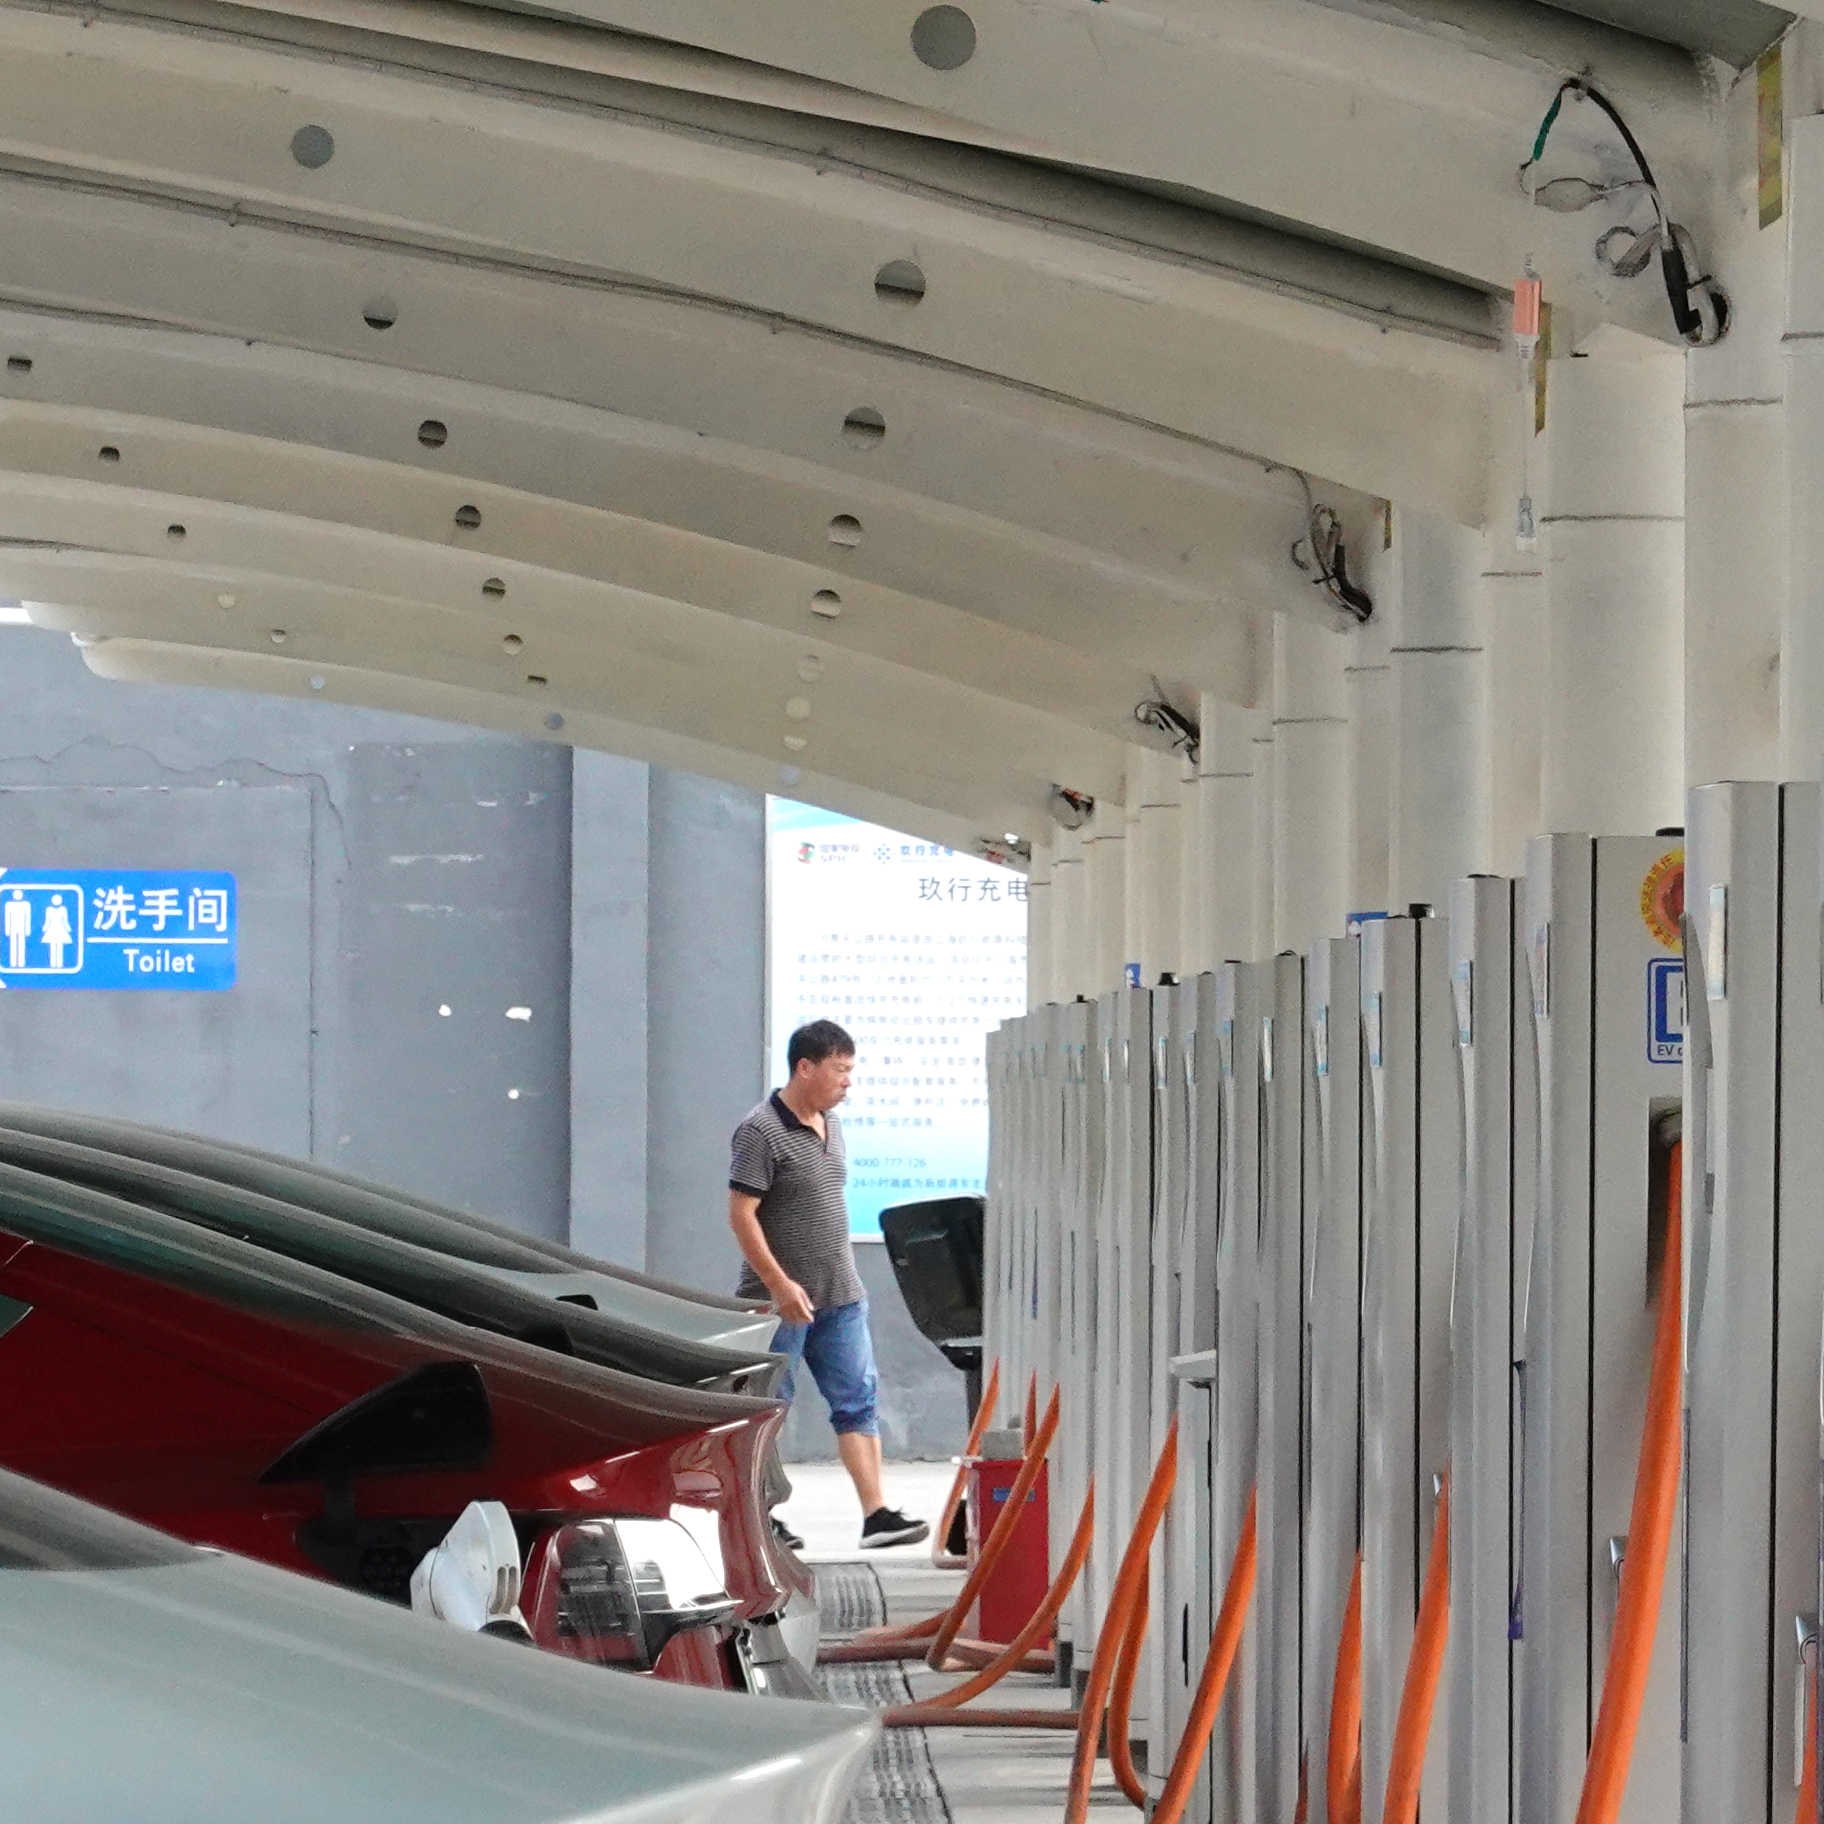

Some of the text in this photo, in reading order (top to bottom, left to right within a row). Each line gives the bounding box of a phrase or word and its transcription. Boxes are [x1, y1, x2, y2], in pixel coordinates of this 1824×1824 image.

[92, 885, 228, 932] 洗手间
[123, 948, 195, 973] Toilet
[1657, 1044, 1674, 1056] EV
